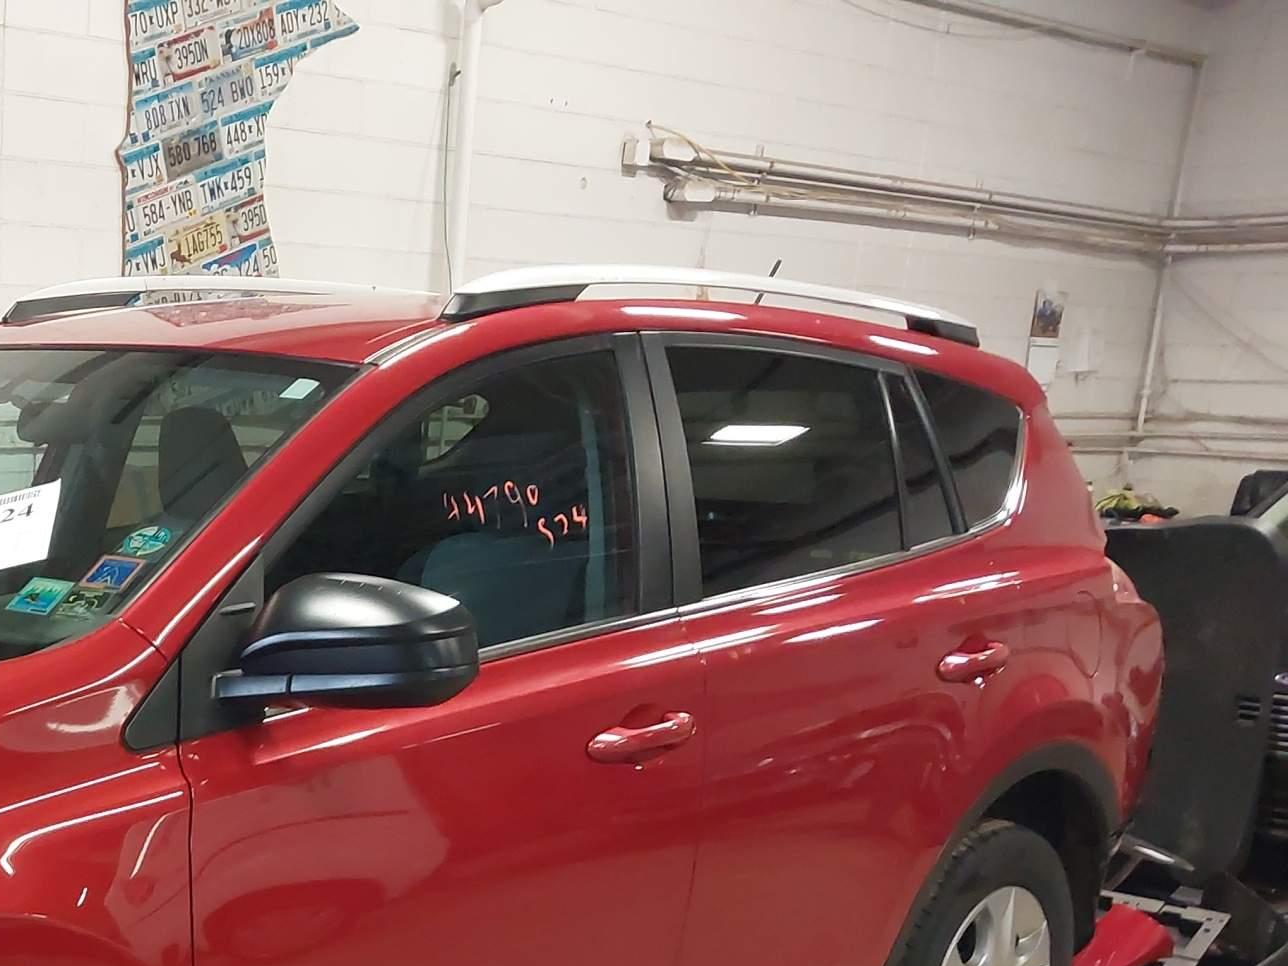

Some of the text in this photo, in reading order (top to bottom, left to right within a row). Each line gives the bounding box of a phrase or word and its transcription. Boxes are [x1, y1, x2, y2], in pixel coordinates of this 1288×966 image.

[308, 1, 329, 26] 232
[200, 86, 225, 114] 524
[199, 177, 225, 204] TWK
[230, 166, 253, 193] 459
